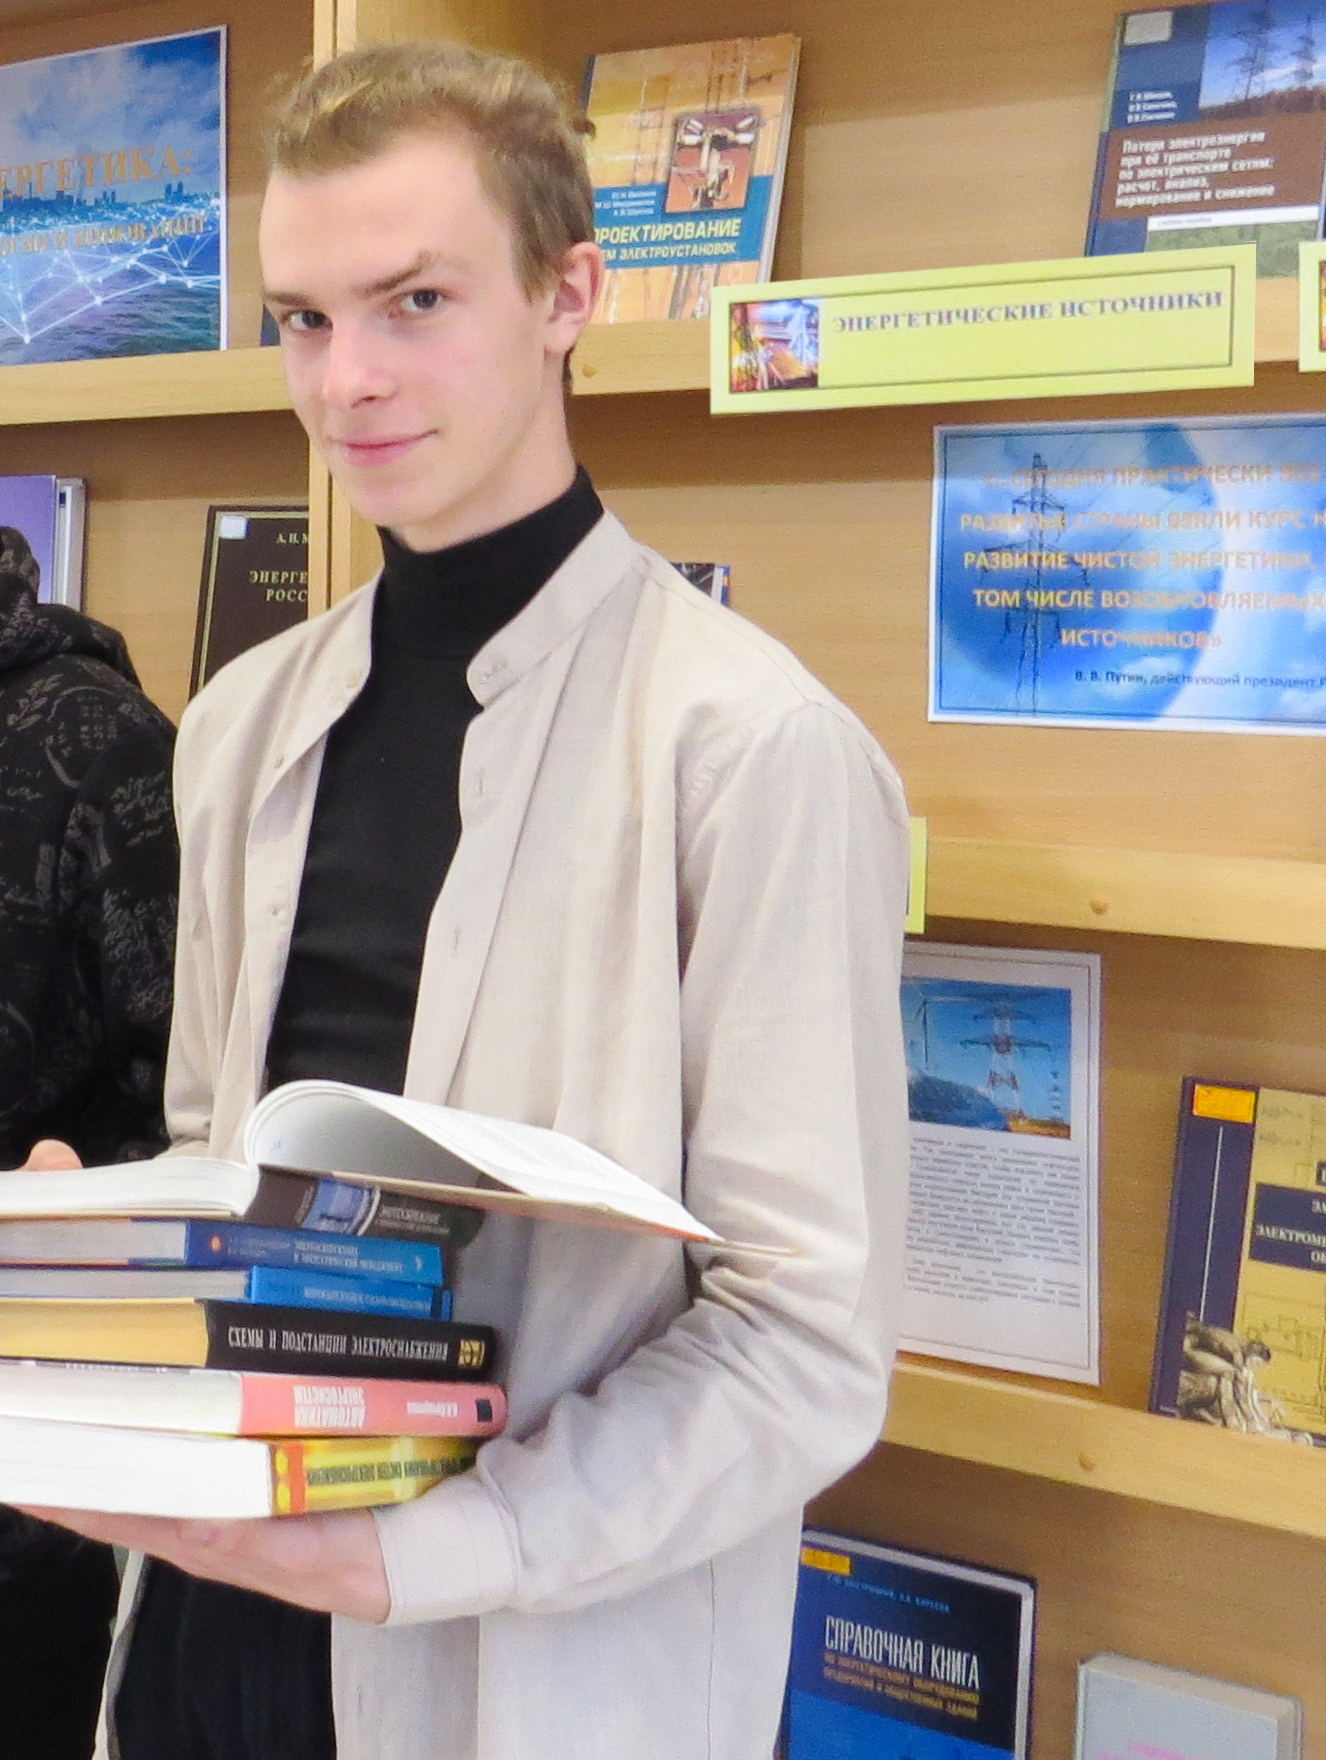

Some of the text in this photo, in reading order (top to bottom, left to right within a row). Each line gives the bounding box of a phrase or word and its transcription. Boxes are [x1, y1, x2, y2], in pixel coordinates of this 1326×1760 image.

[594, 218, 742, 245] ПРОЕКТИРОВАНИЕ
[619, 241, 737, 261] ЭЛЕКТРОУСТАНОВОК
[833, 291, 1223, 333] ЭНЕРГЕТИЧЕСКИЕ ИСТОЧНИКИ
[1248, 510, 1307, 529] КУРС
[964, 551, 1069, 570] РАЗВИТИЕ
[1074, 547, 1162, 570] ЧИСТОЙ
[249, 570, 308, 584] ЭНЕРГЕ
[265, 588, 308, 602] РОСС
[973, 588, 1020, 608] ТОМ
[1025, 589, 1094, 608] ЧИСЛЕ
[1075, 670, 1087, 682] В.
[1090, 671, 1102, 682] В.
[1105, 671, 1148, 684] Путин,
[1243, 674, 1316, 688] президент
[227, 1326, 449, 1362] СХЕМЫ И ПОДСТАНЦИИ ЭЛЕКТРОСНАБЖЕНИЯ
[294, 1405, 366, 1429] АВТОМАТИКА
[825, 1614, 981, 1691] СПРАВОЧНАЯ КНИГА
